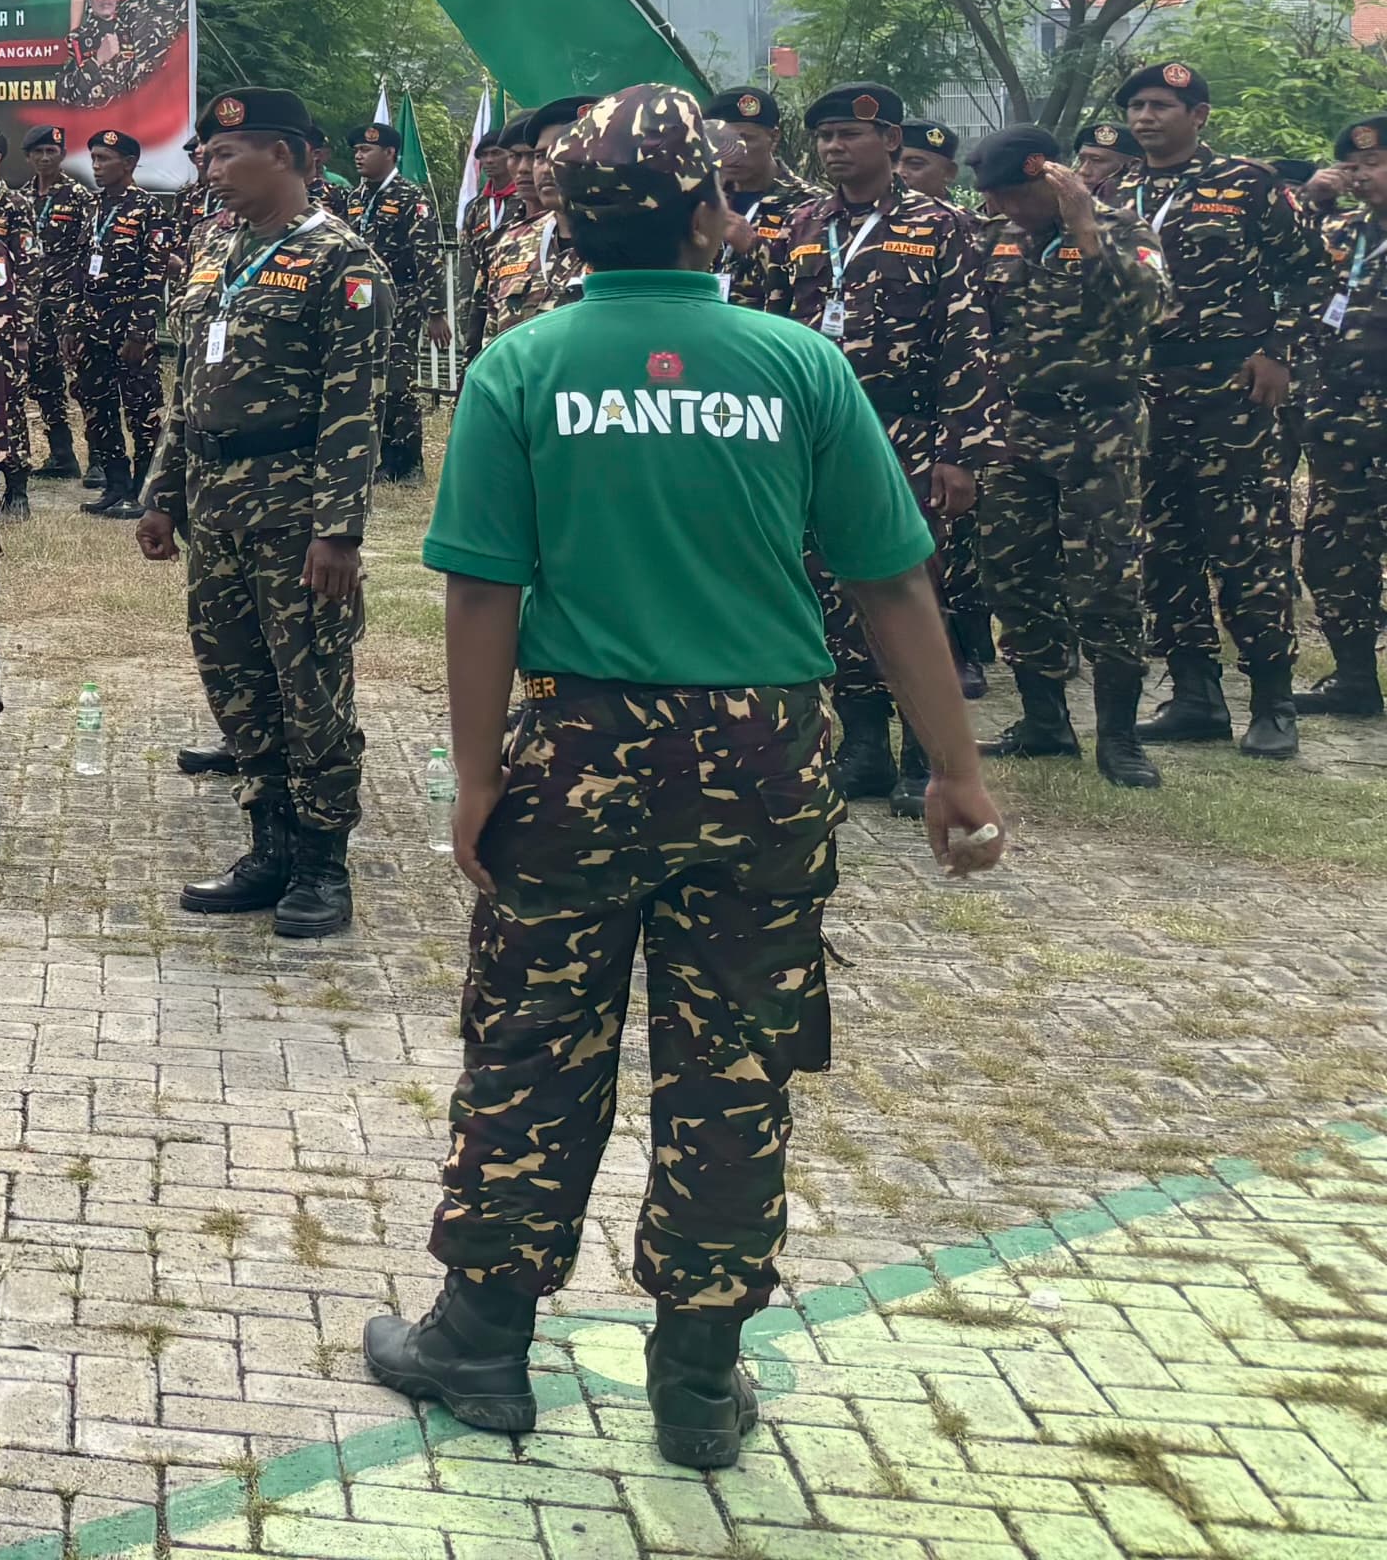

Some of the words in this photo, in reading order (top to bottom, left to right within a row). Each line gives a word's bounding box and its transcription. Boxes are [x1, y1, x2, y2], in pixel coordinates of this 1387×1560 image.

[885, 242, 934, 255] BANSER
[258, 270, 308, 292] BANSER
[555, 389, 782, 442] DANTON
